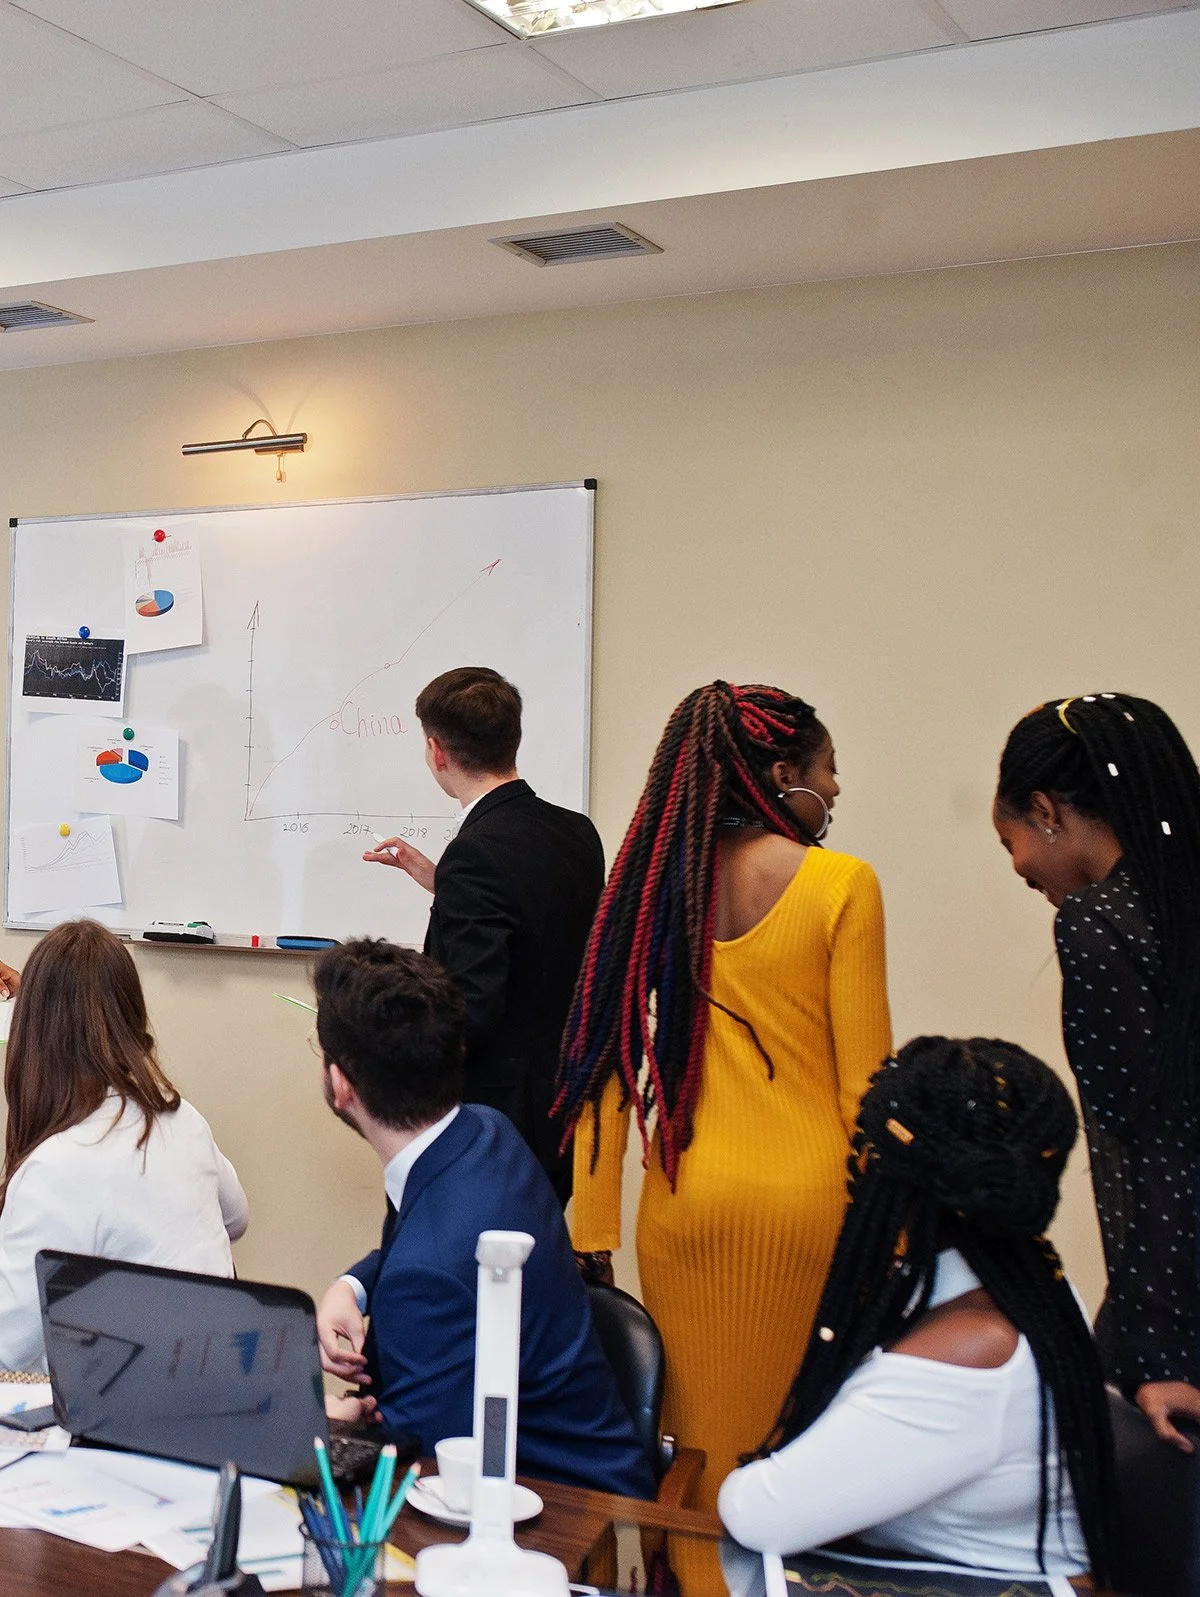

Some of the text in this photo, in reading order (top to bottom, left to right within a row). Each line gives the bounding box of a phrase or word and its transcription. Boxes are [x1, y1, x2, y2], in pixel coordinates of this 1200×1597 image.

[341, 700, 408, 738] China
[283, 822, 310, 833] 2016
[343, 823, 372, 835] 2017
[400, 826, 428, 838] 2018
